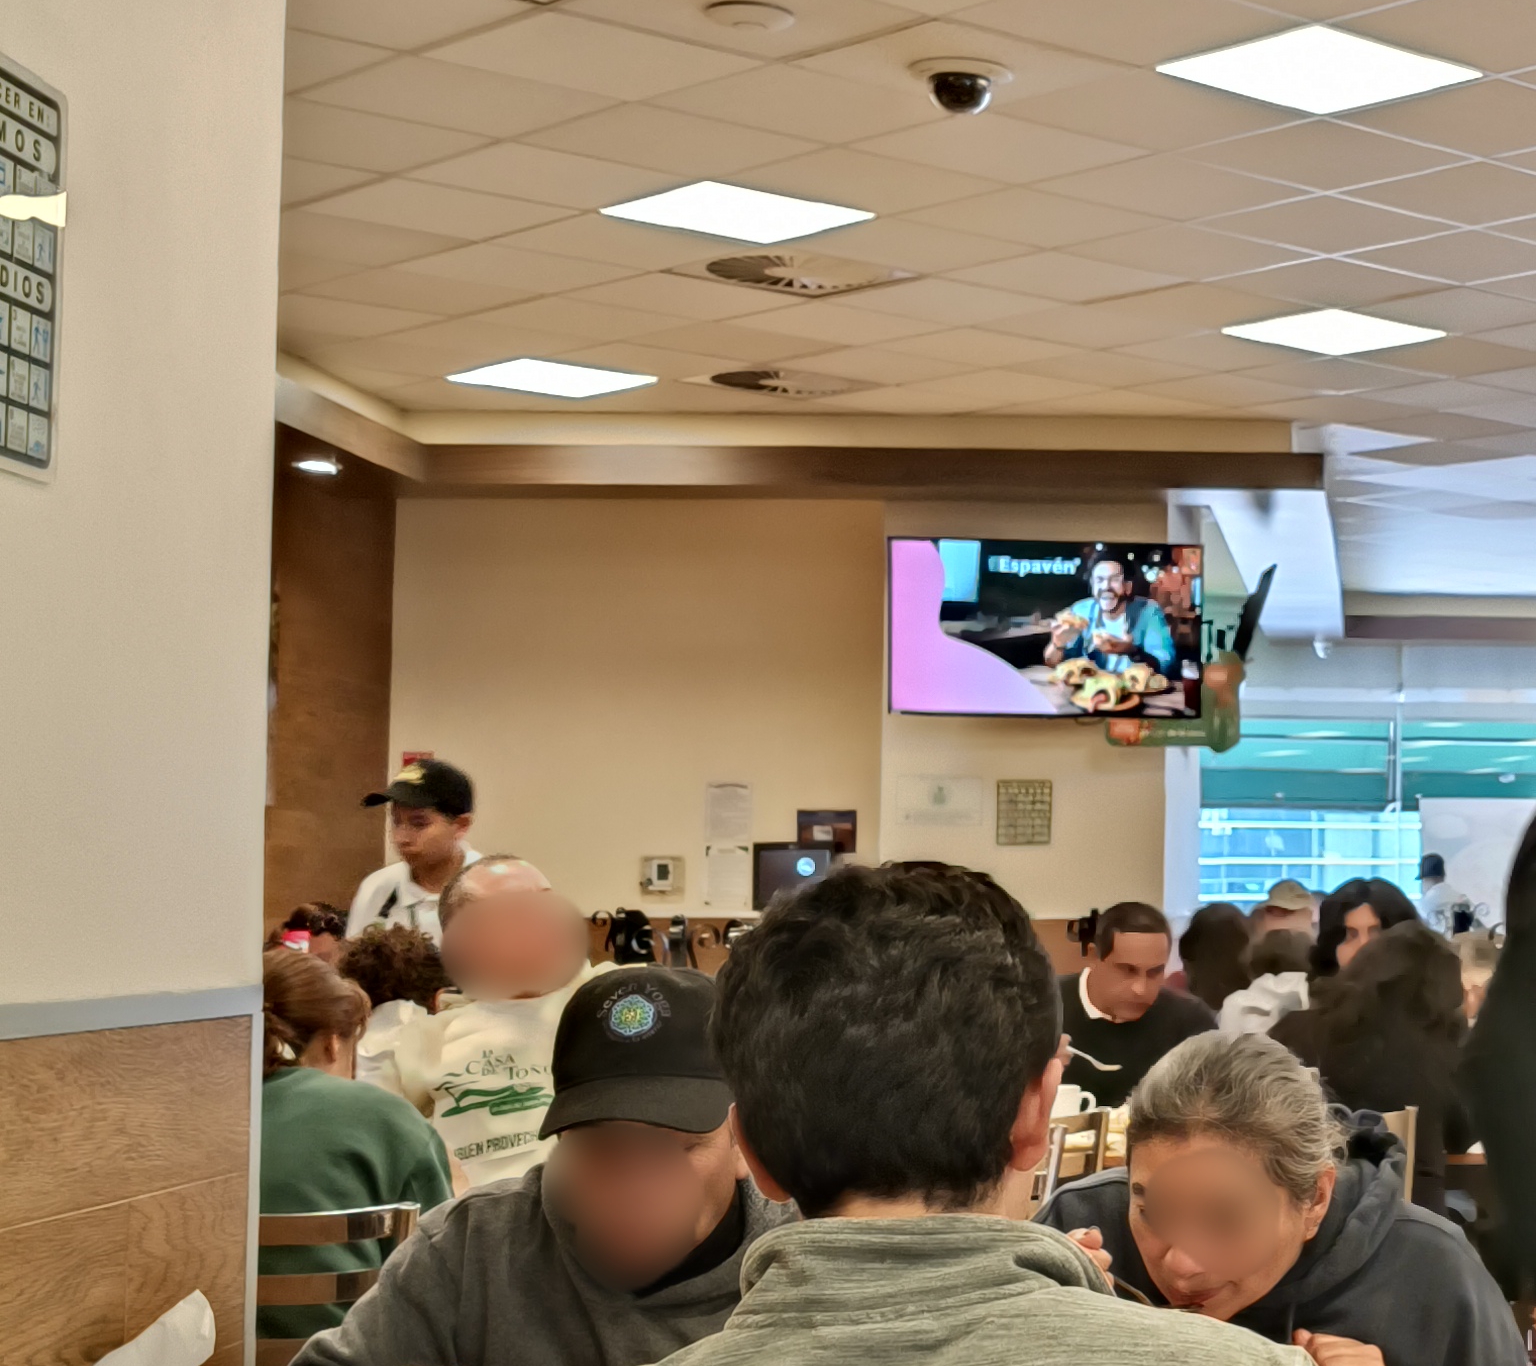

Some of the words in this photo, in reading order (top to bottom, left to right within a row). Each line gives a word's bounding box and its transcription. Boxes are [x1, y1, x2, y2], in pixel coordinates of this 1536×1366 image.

[998, 555, 1078, 577] Espavén
[596, 983, 637, 1018] Seven
[645, 982, 671, 1018] Yoga
[465, 1053, 516, 1076] CASA
